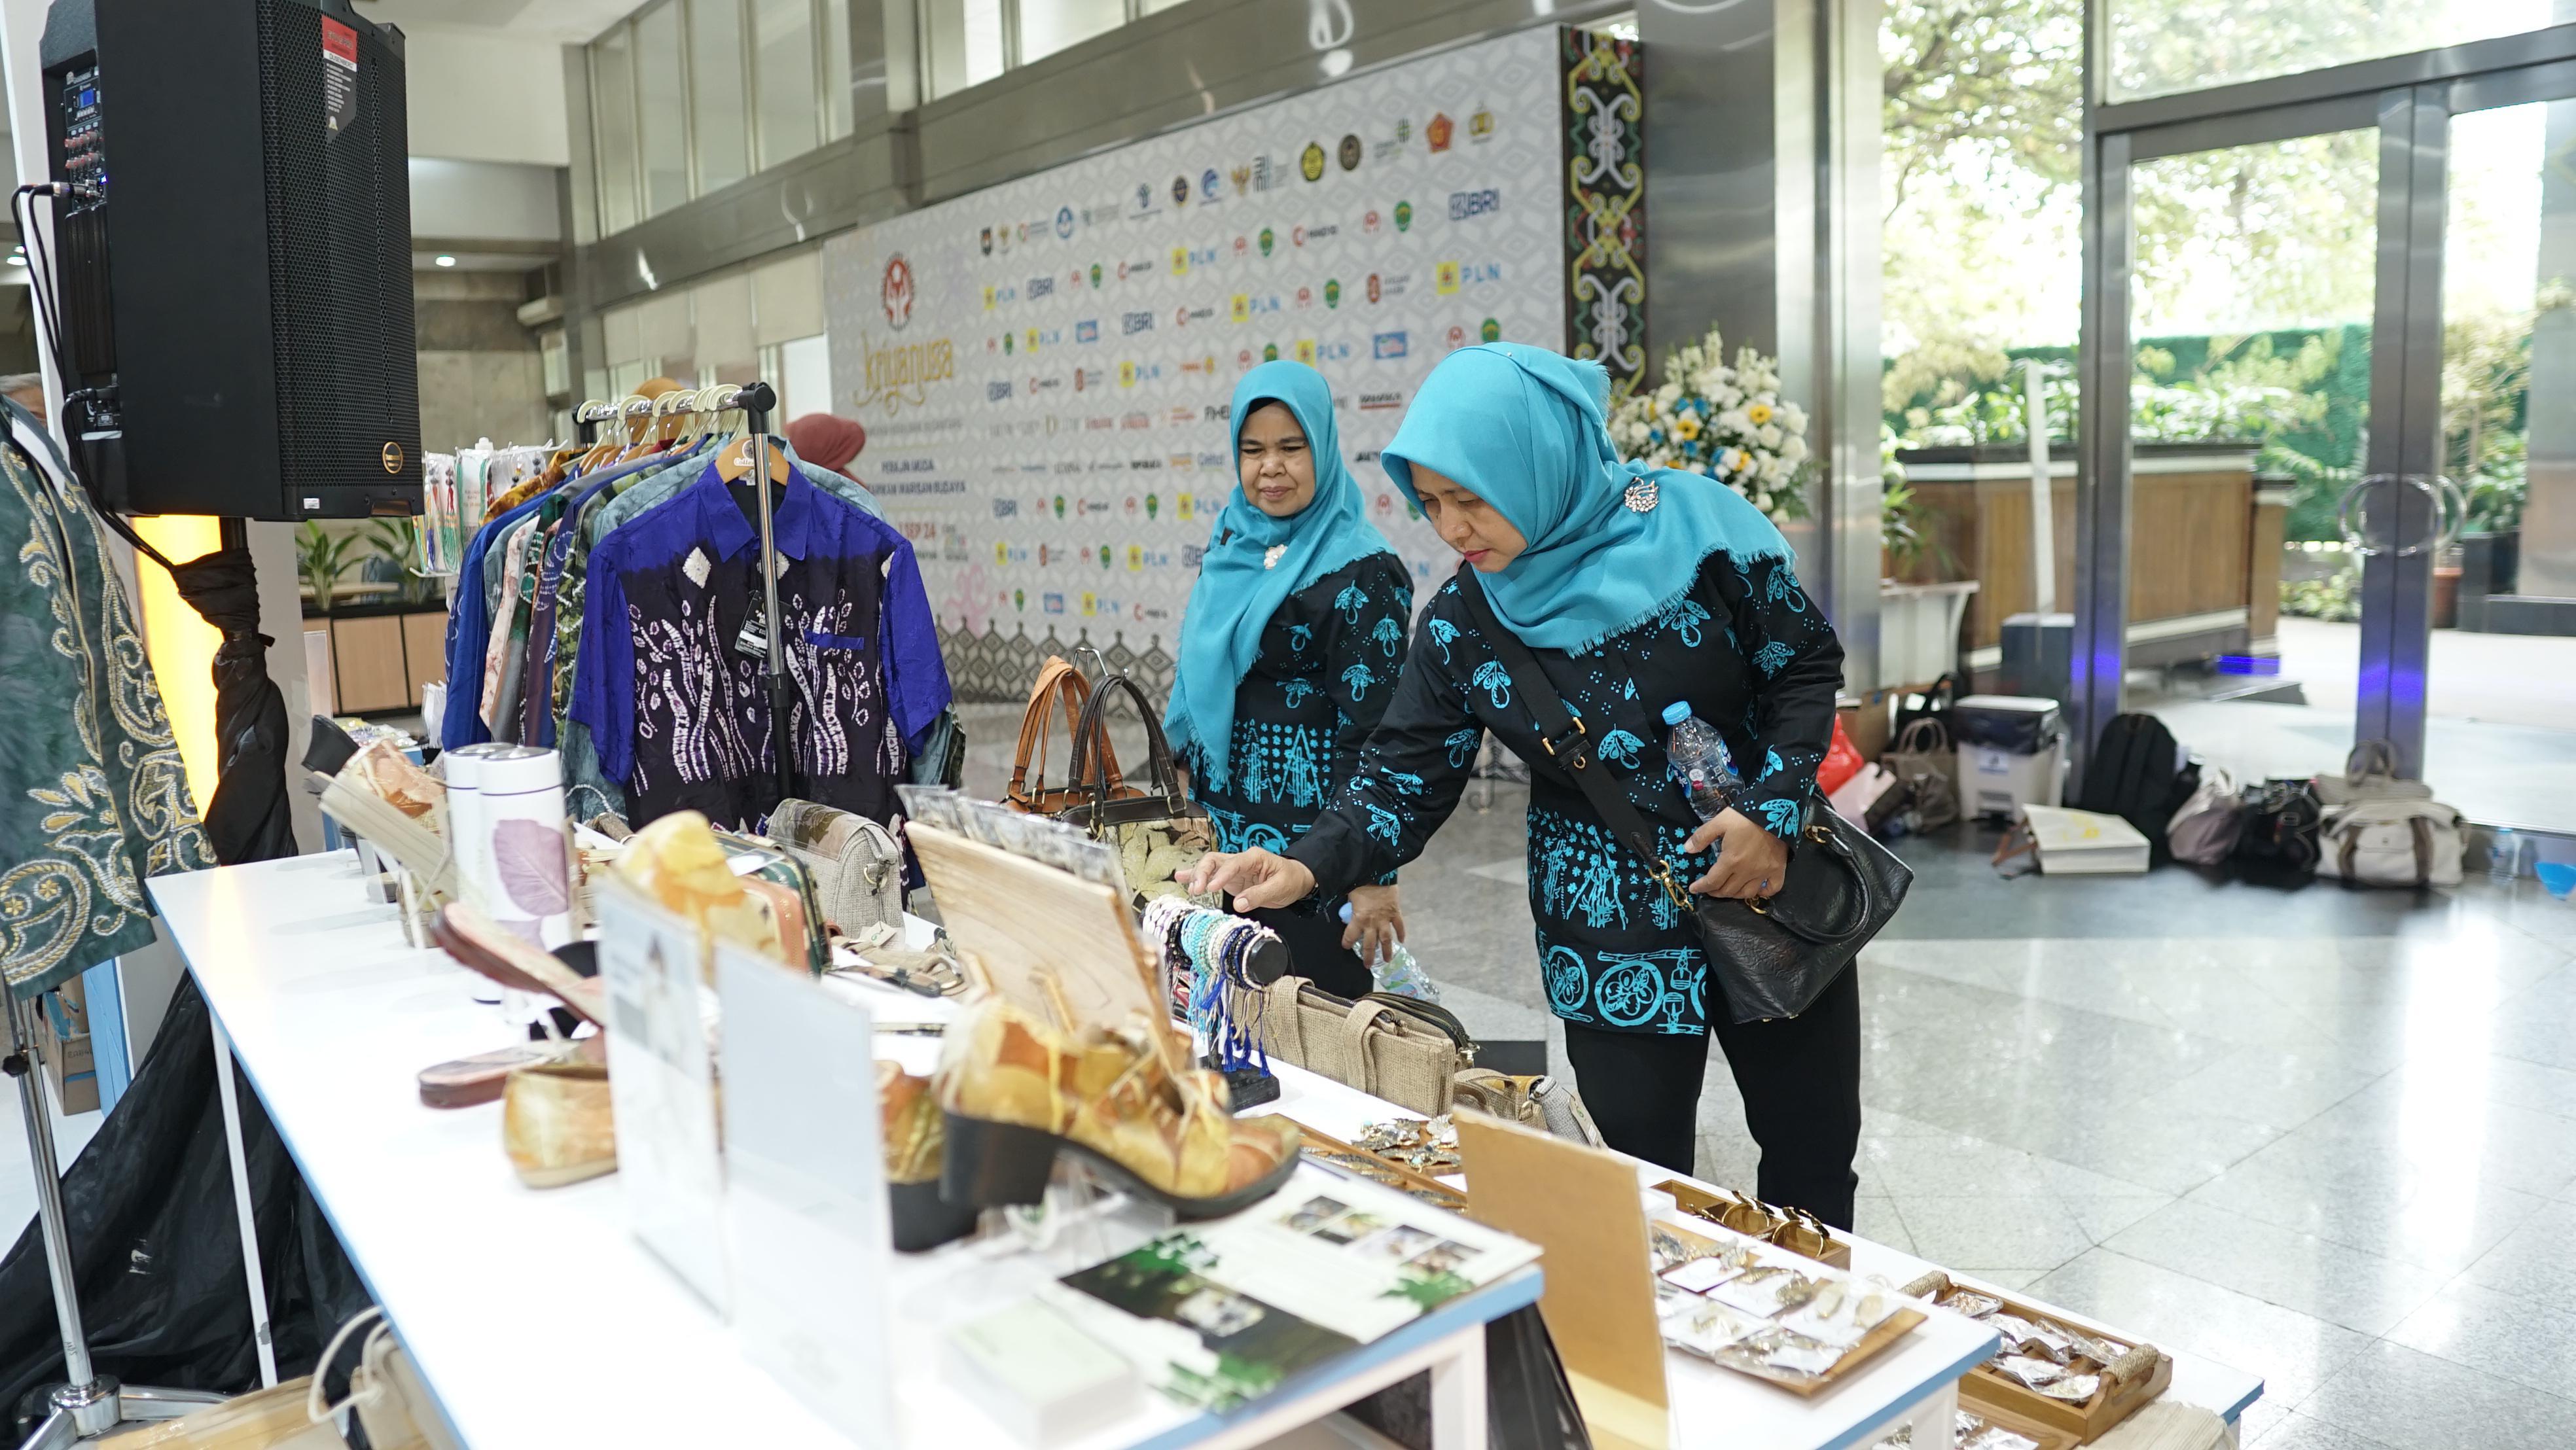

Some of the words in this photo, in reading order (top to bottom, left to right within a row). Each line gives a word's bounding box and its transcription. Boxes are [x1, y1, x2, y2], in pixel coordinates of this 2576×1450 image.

[1466, 188, 1500, 216] BRI
[1461, 264, 1501, 283] PLN
[1249, 296, 1280, 313] PLN
[1317, 344, 1350, 359] PLN
[1143, 550, 1168, 566] PLN
